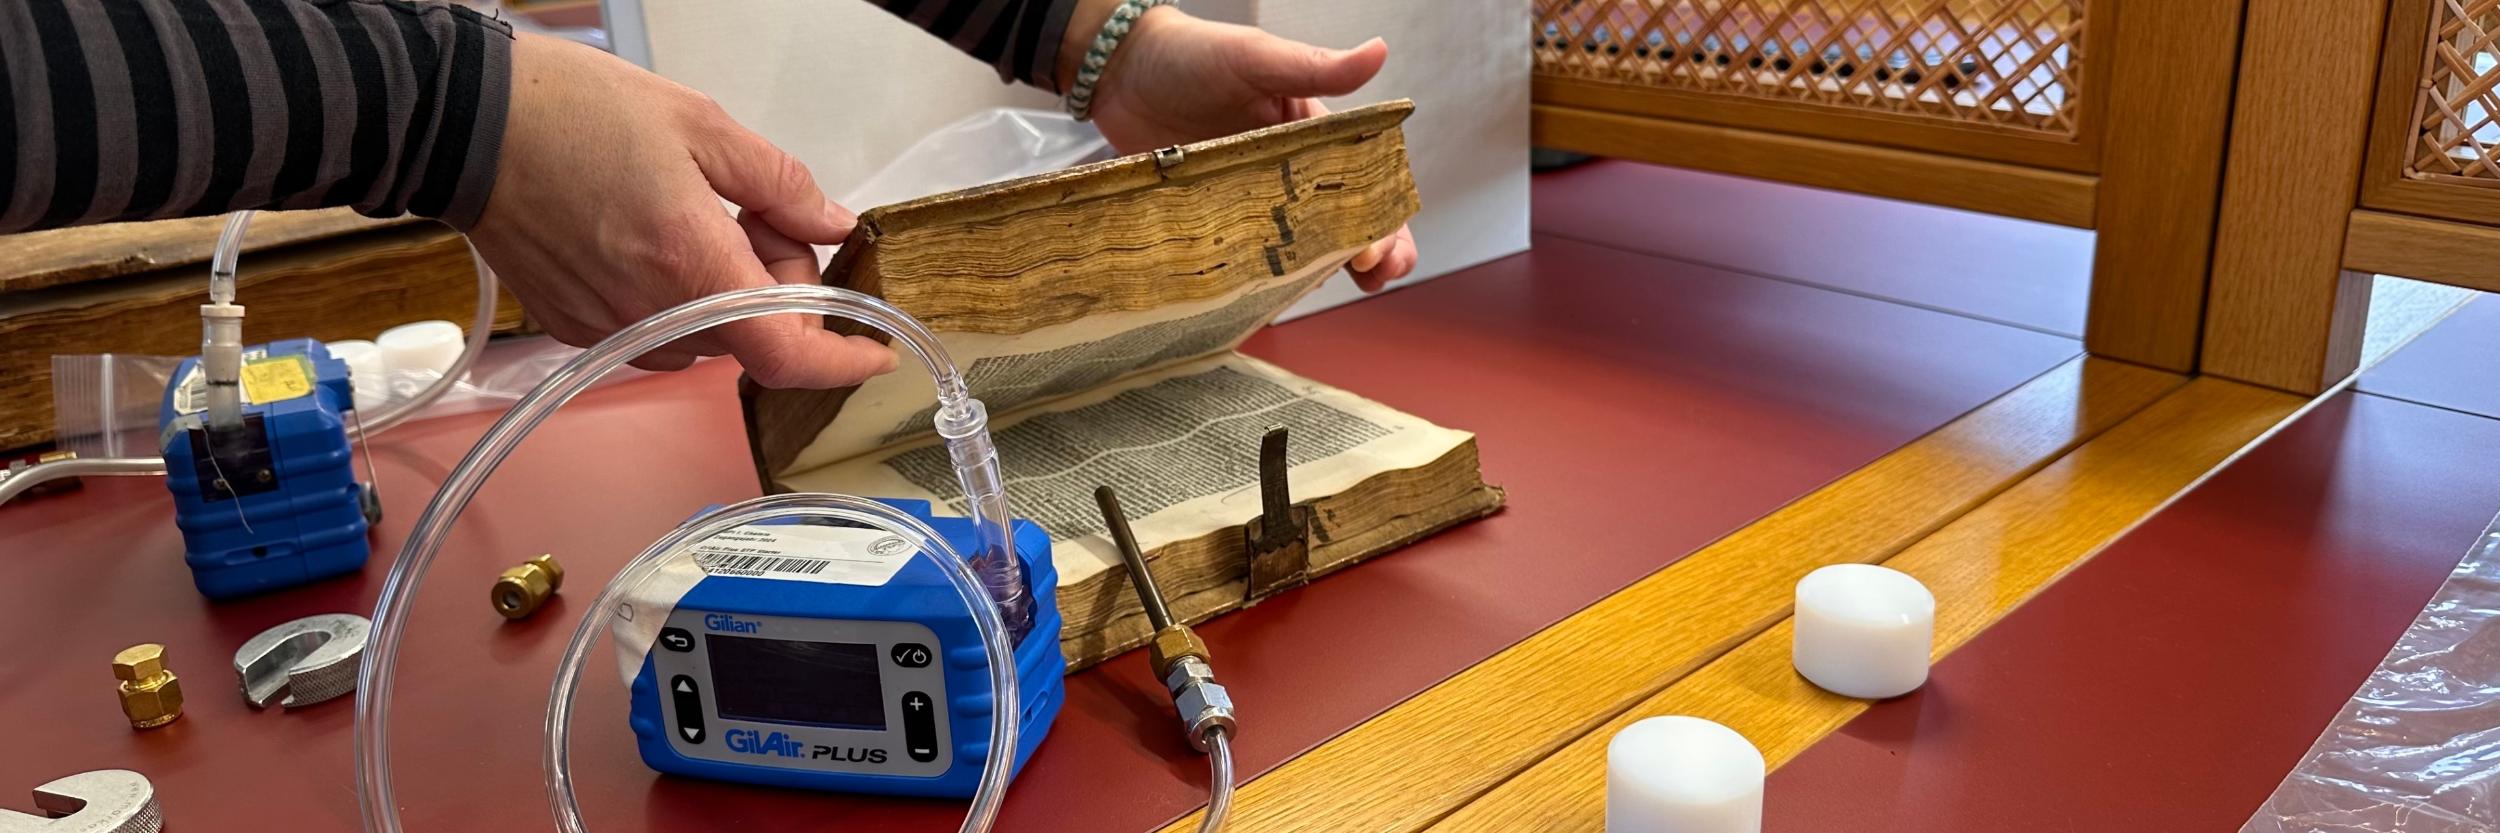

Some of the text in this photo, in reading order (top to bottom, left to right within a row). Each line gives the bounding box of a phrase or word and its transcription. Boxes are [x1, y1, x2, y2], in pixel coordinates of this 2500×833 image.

[704, 613, 757, 634] Gilian
[725, 728, 888, 764] GilAir PLUS
